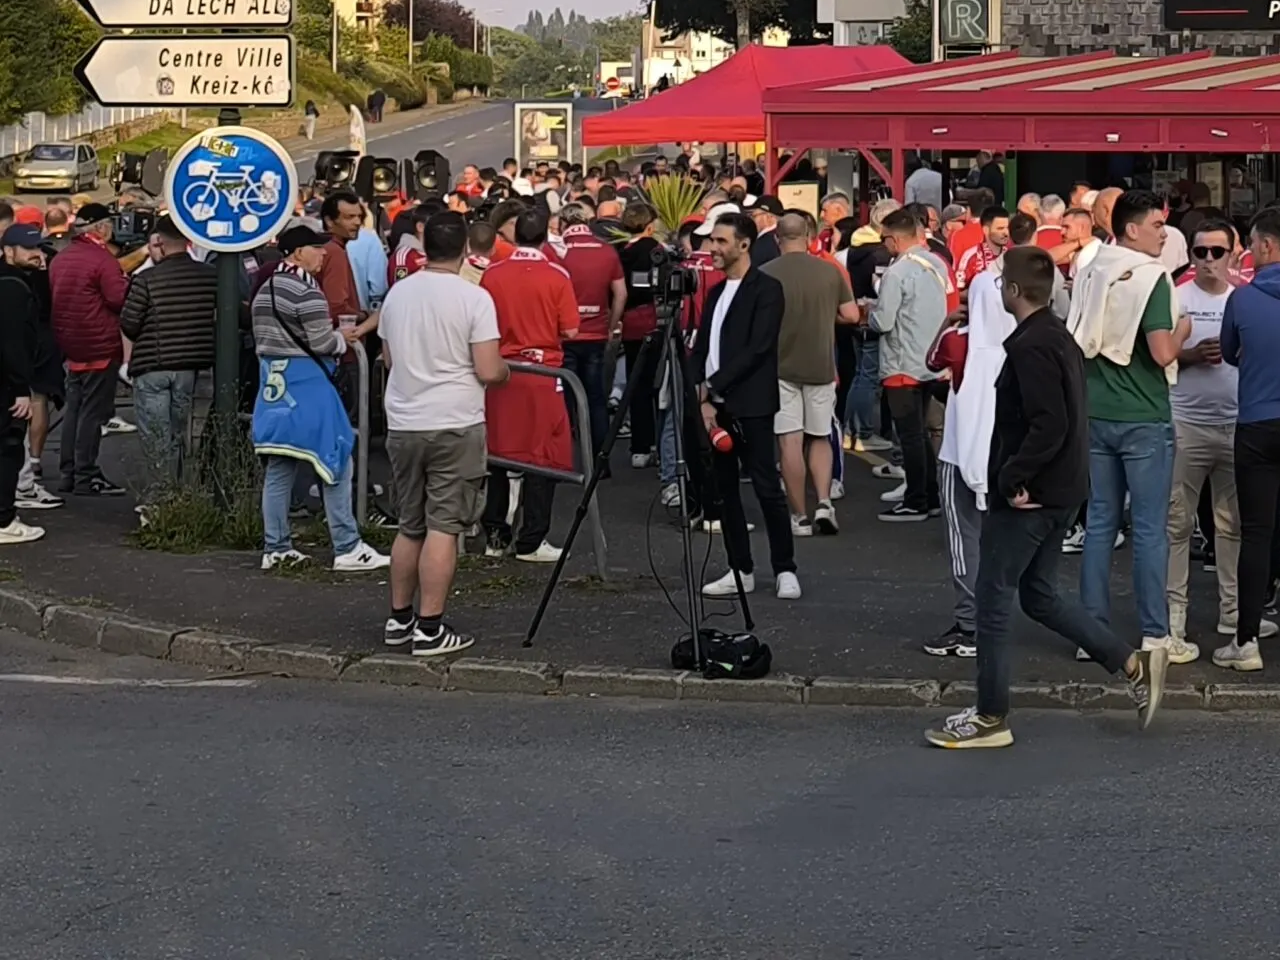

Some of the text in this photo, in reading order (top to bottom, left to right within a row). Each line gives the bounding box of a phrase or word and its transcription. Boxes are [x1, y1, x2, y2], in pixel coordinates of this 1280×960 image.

[158, 47, 283, 67] Centre Ville
[262, 358, 289, 403] 5
